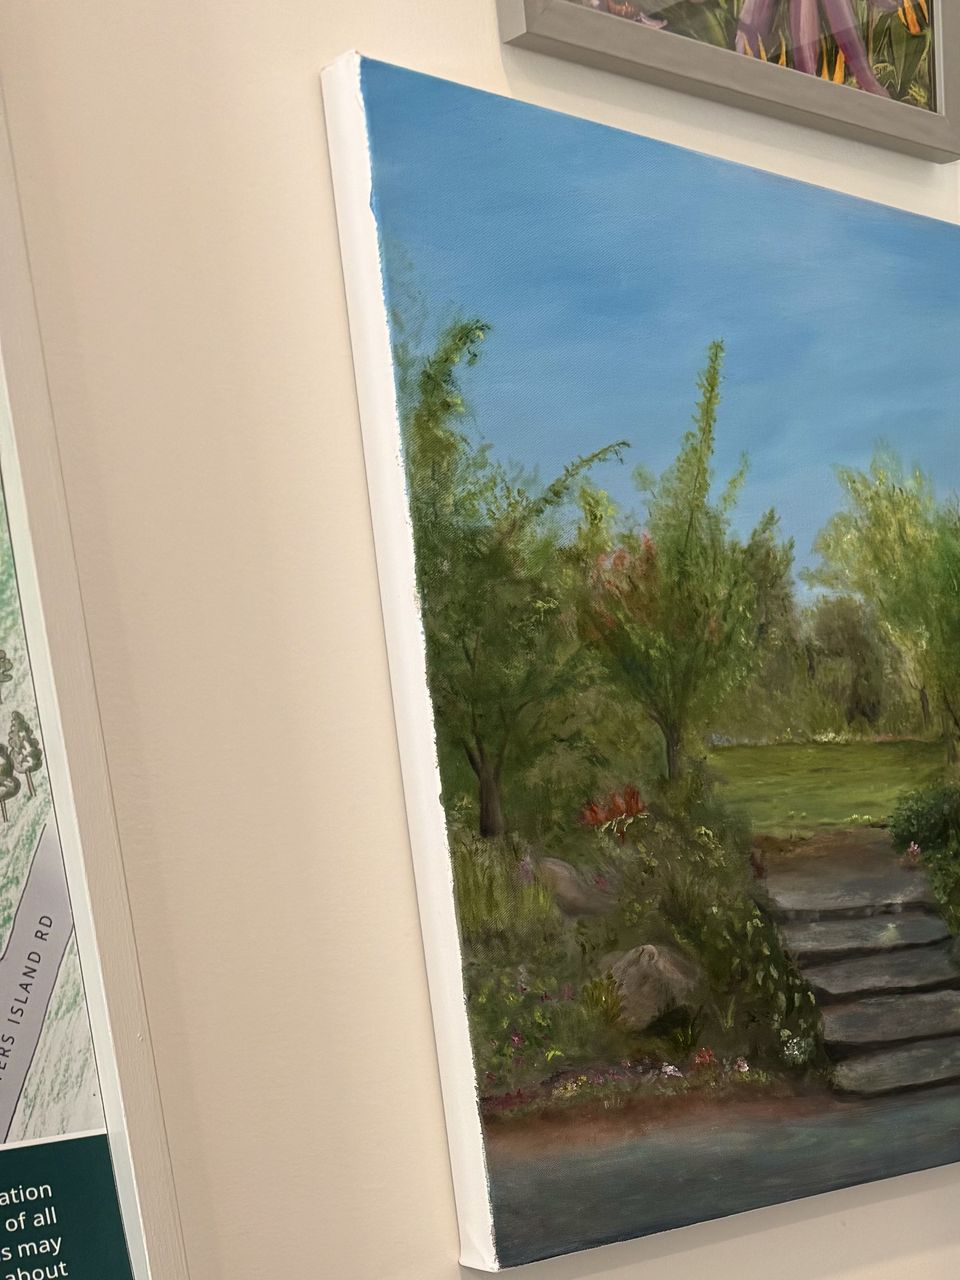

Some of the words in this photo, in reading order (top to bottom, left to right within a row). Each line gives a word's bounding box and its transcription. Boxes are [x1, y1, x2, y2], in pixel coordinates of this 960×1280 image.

[0, 1034, 15, 1080] ERS
[8, 951, 41, 1025] ISLAND
[34, 915, 53, 942] RD
[5, 1211, 26, 1232] of
[33, 1206, 57, 1227] all
[17, 1237, 61, 1258] may
